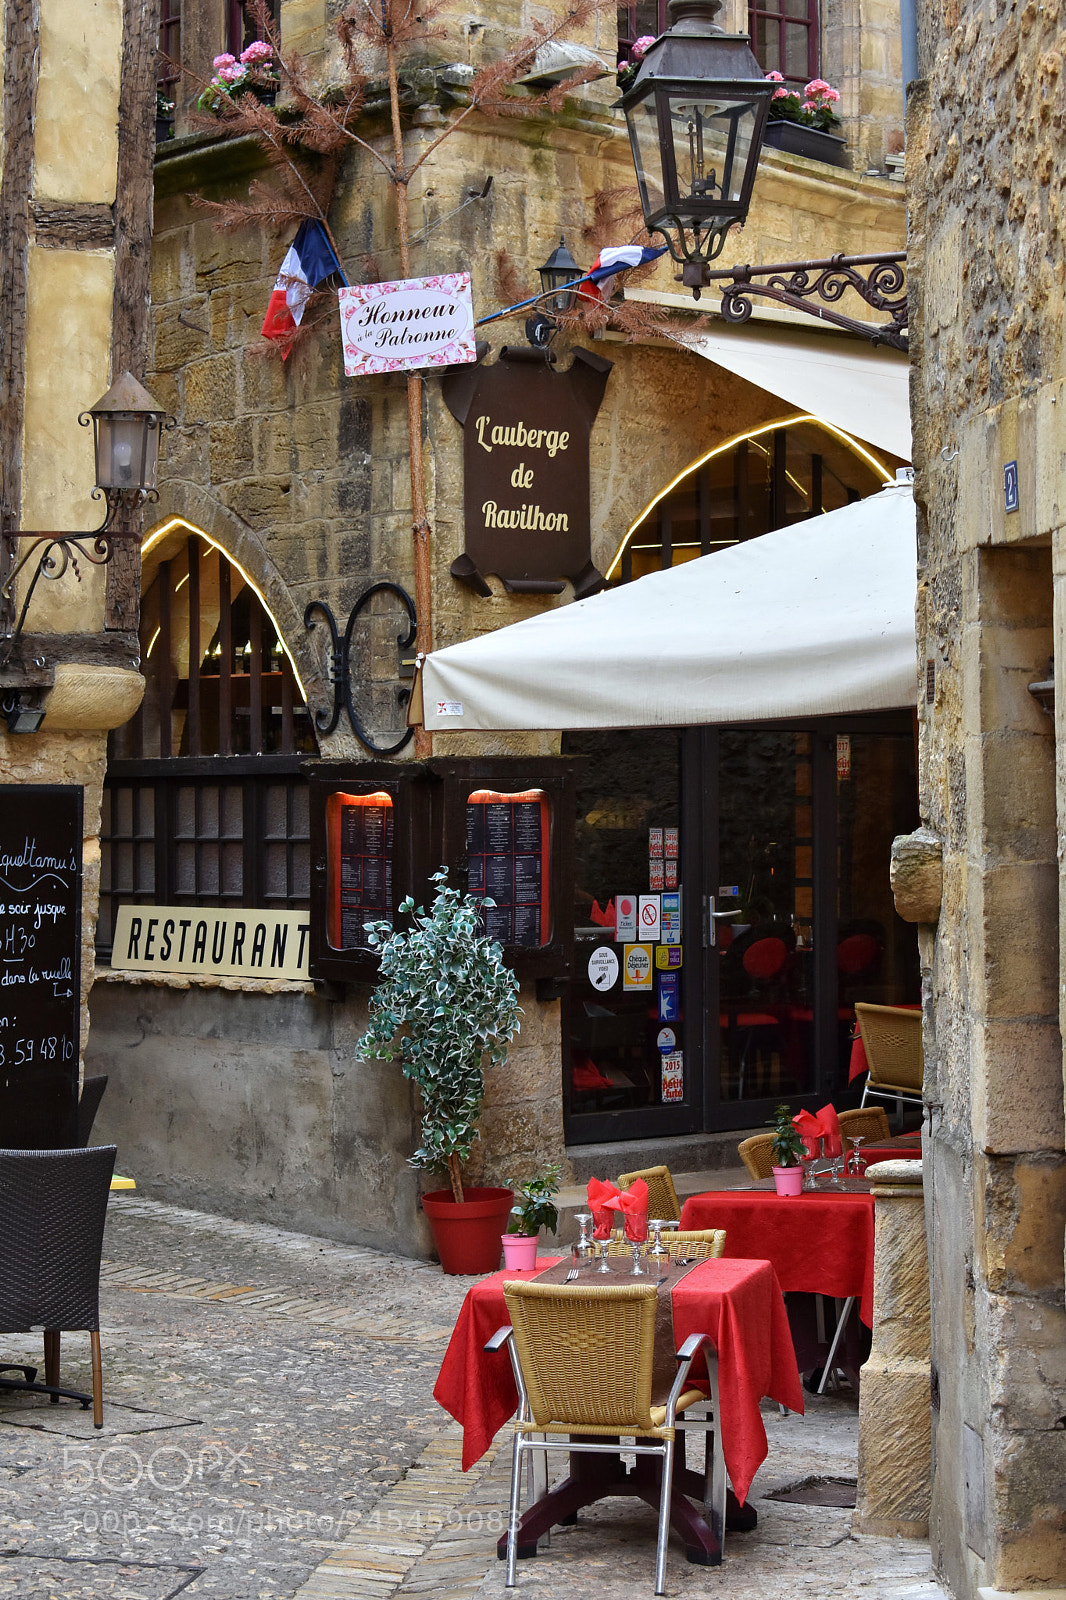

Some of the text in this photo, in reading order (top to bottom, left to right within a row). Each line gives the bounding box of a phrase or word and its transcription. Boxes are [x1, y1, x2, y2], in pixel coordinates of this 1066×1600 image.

[358, 301, 460, 327] Honneur
[364, 329, 373, 339] la
[374, 327, 458, 348] Patronne
[475, 416, 570, 457] L'auberge
[511, 463, 534, 488] de
[482, 500, 569, 531] Ravilhon
[8, 900, 31, 915] soir
[34, 897, 67, 929] jusque
[0, 924, 36, 955] H30
[127, 918, 310, 969] RESTAURANT
[1, 969, 26, 986] dans
[28, 966, 40, 985] la
[40, 1036, 58, 1060] 48
[665, 1061, 680, 1071] 2015
